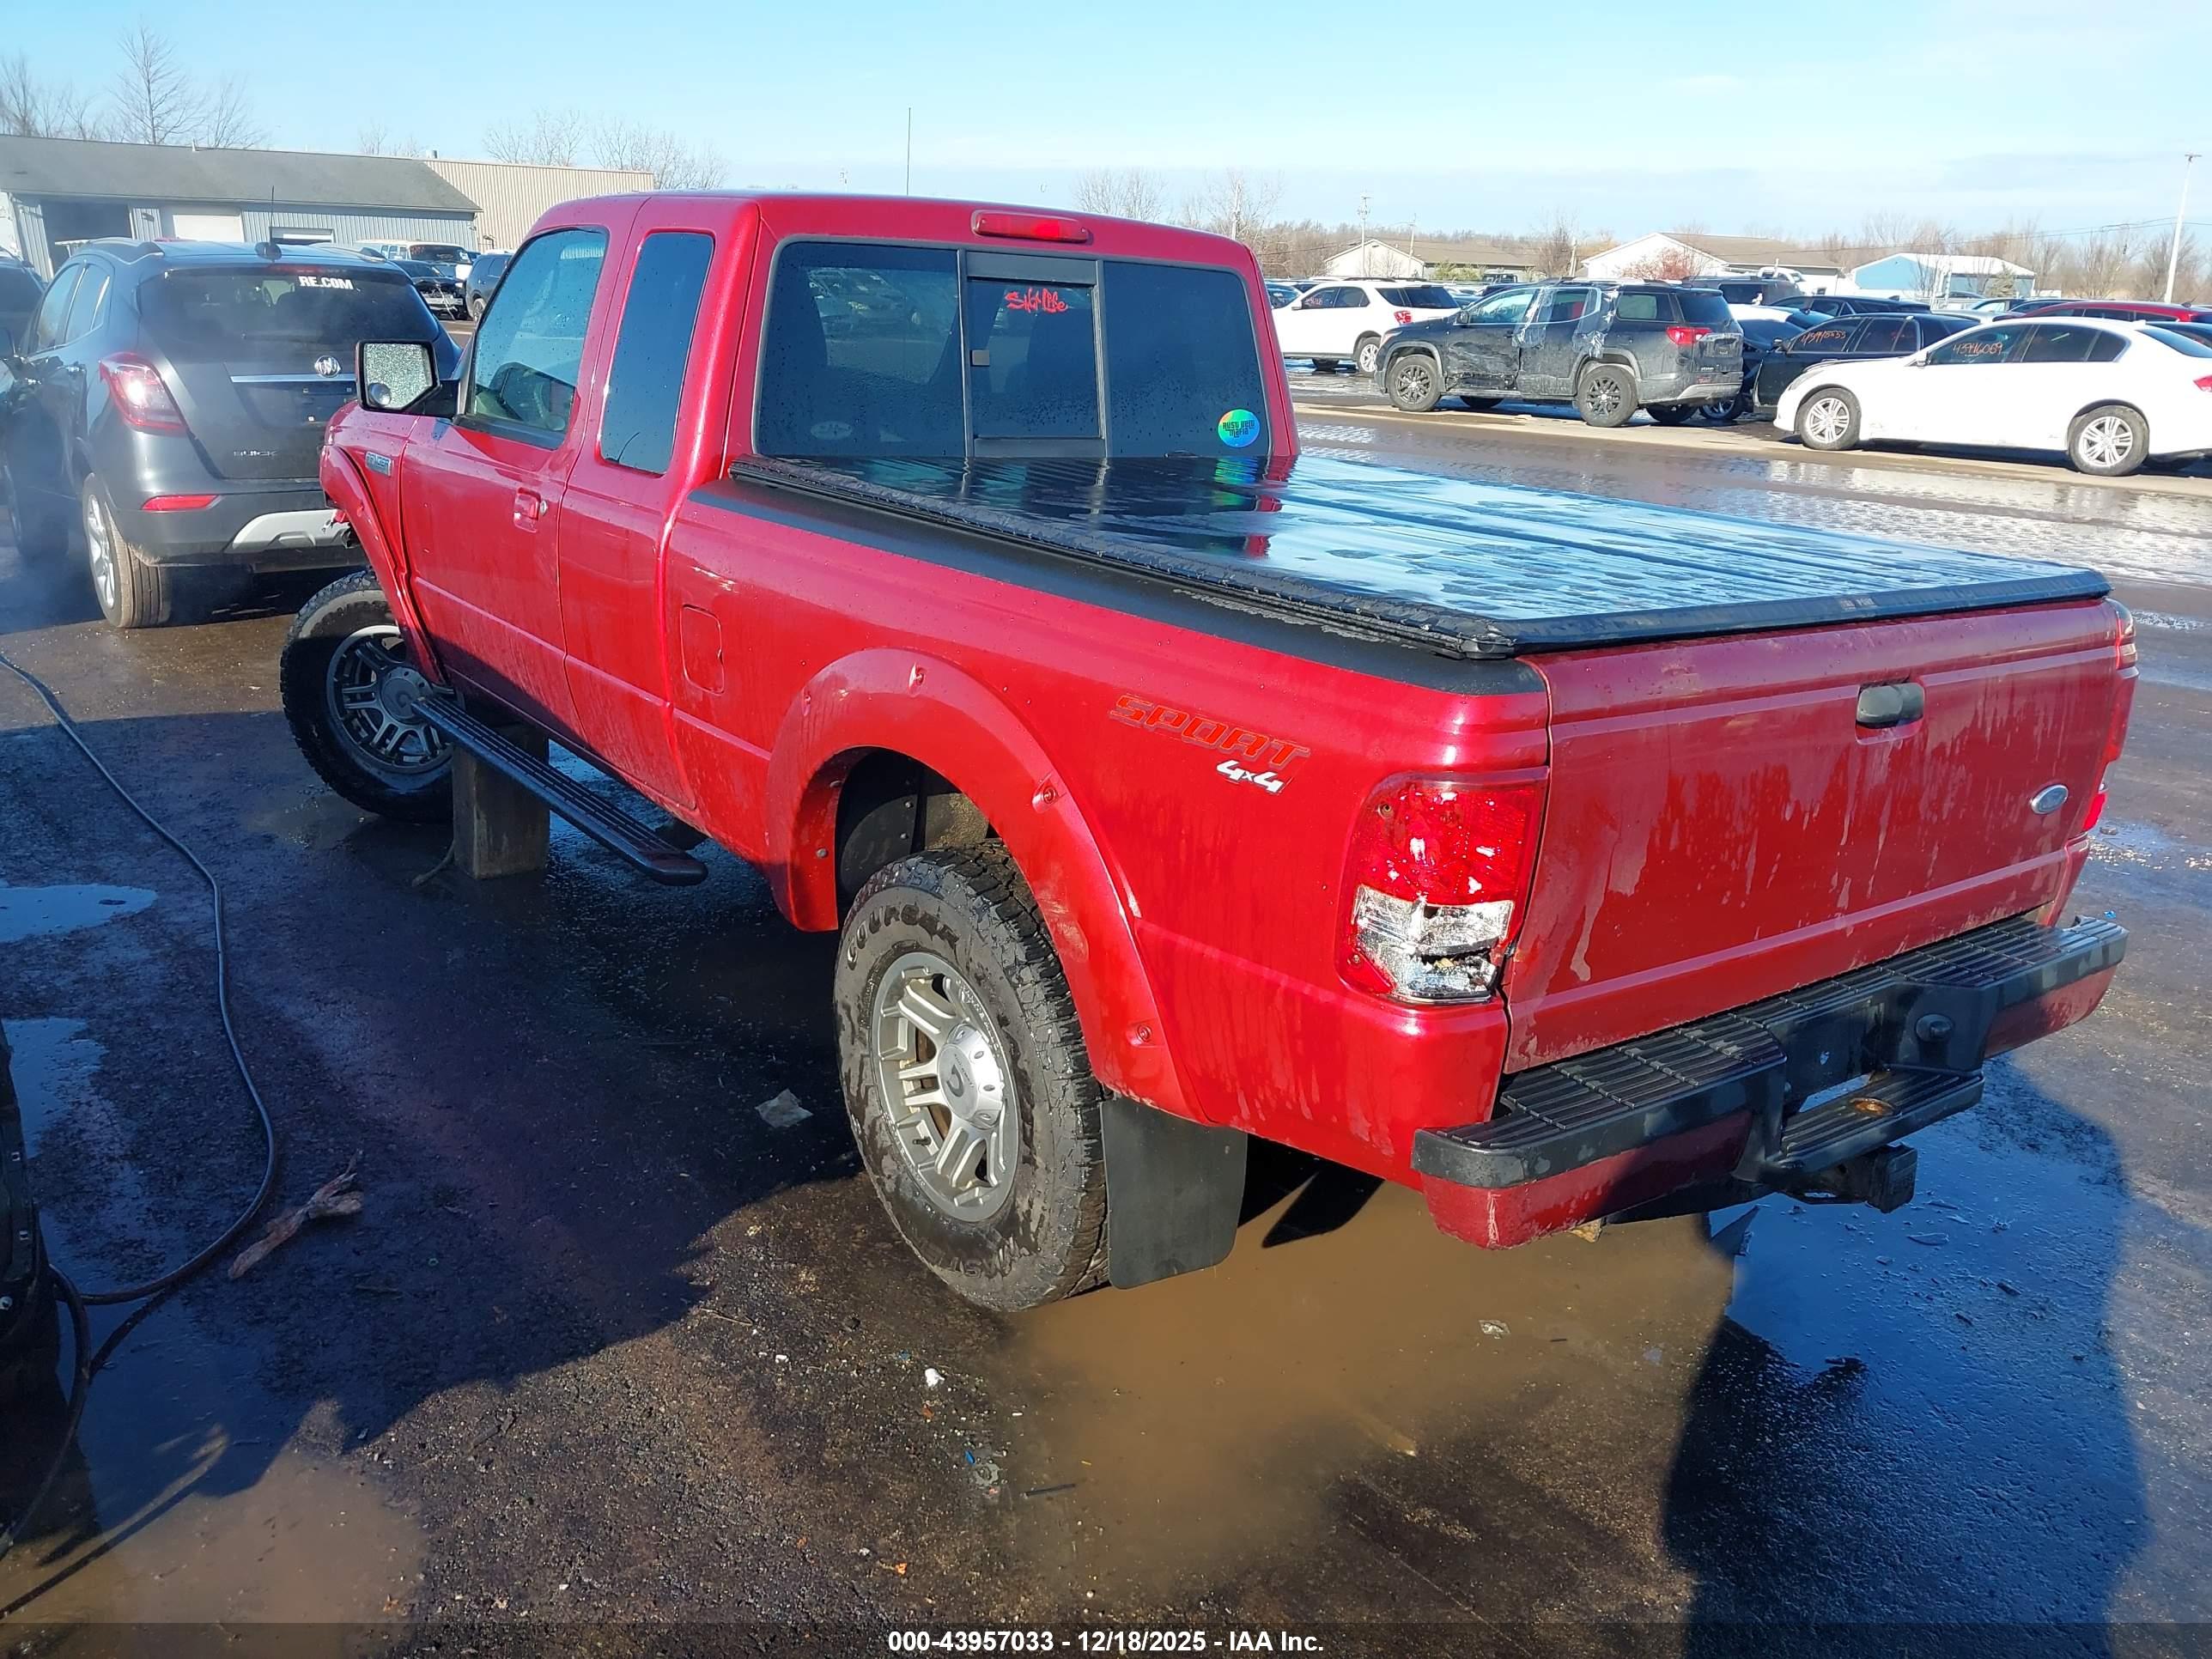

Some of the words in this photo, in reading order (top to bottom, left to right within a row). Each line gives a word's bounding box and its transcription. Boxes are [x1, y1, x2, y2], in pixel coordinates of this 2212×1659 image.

[298, 275, 354, 290] RE.COM
[1109, 695, 1310, 769] SPORT
[1215, 758, 1285, 794] 4x4
